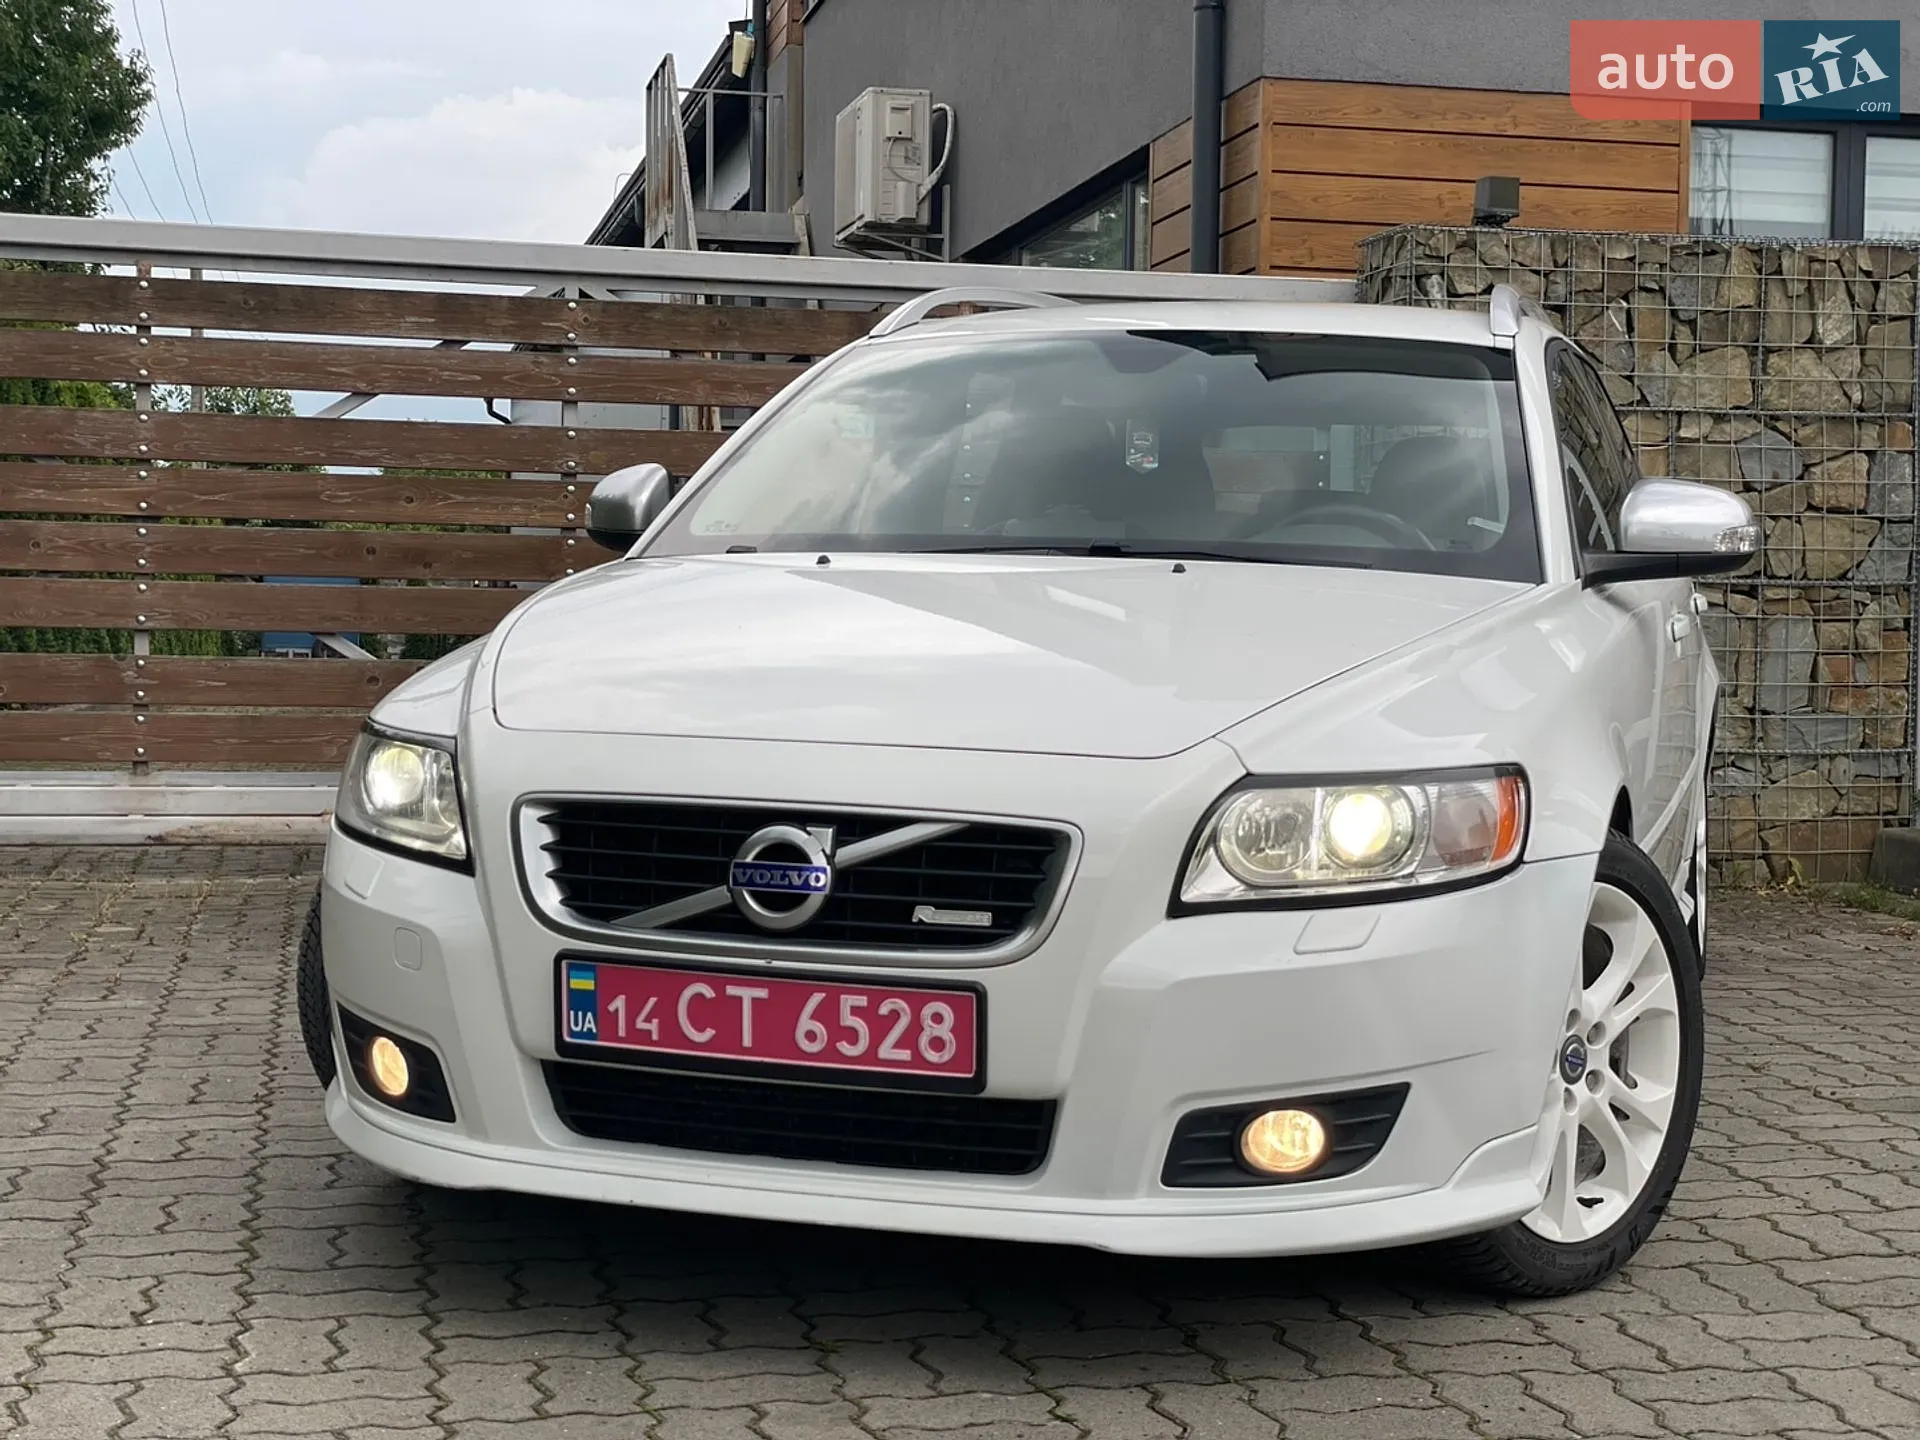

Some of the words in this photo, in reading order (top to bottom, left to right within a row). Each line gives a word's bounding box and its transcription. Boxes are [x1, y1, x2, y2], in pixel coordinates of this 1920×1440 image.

[733, 867, 827, 888] VOLVO
[569, 1009, 597, 1034] UA
[606, 994, 660, 1041] 14
[677, 982, 769, 1048] CT
[794, 992, 957, 1064] 6528
